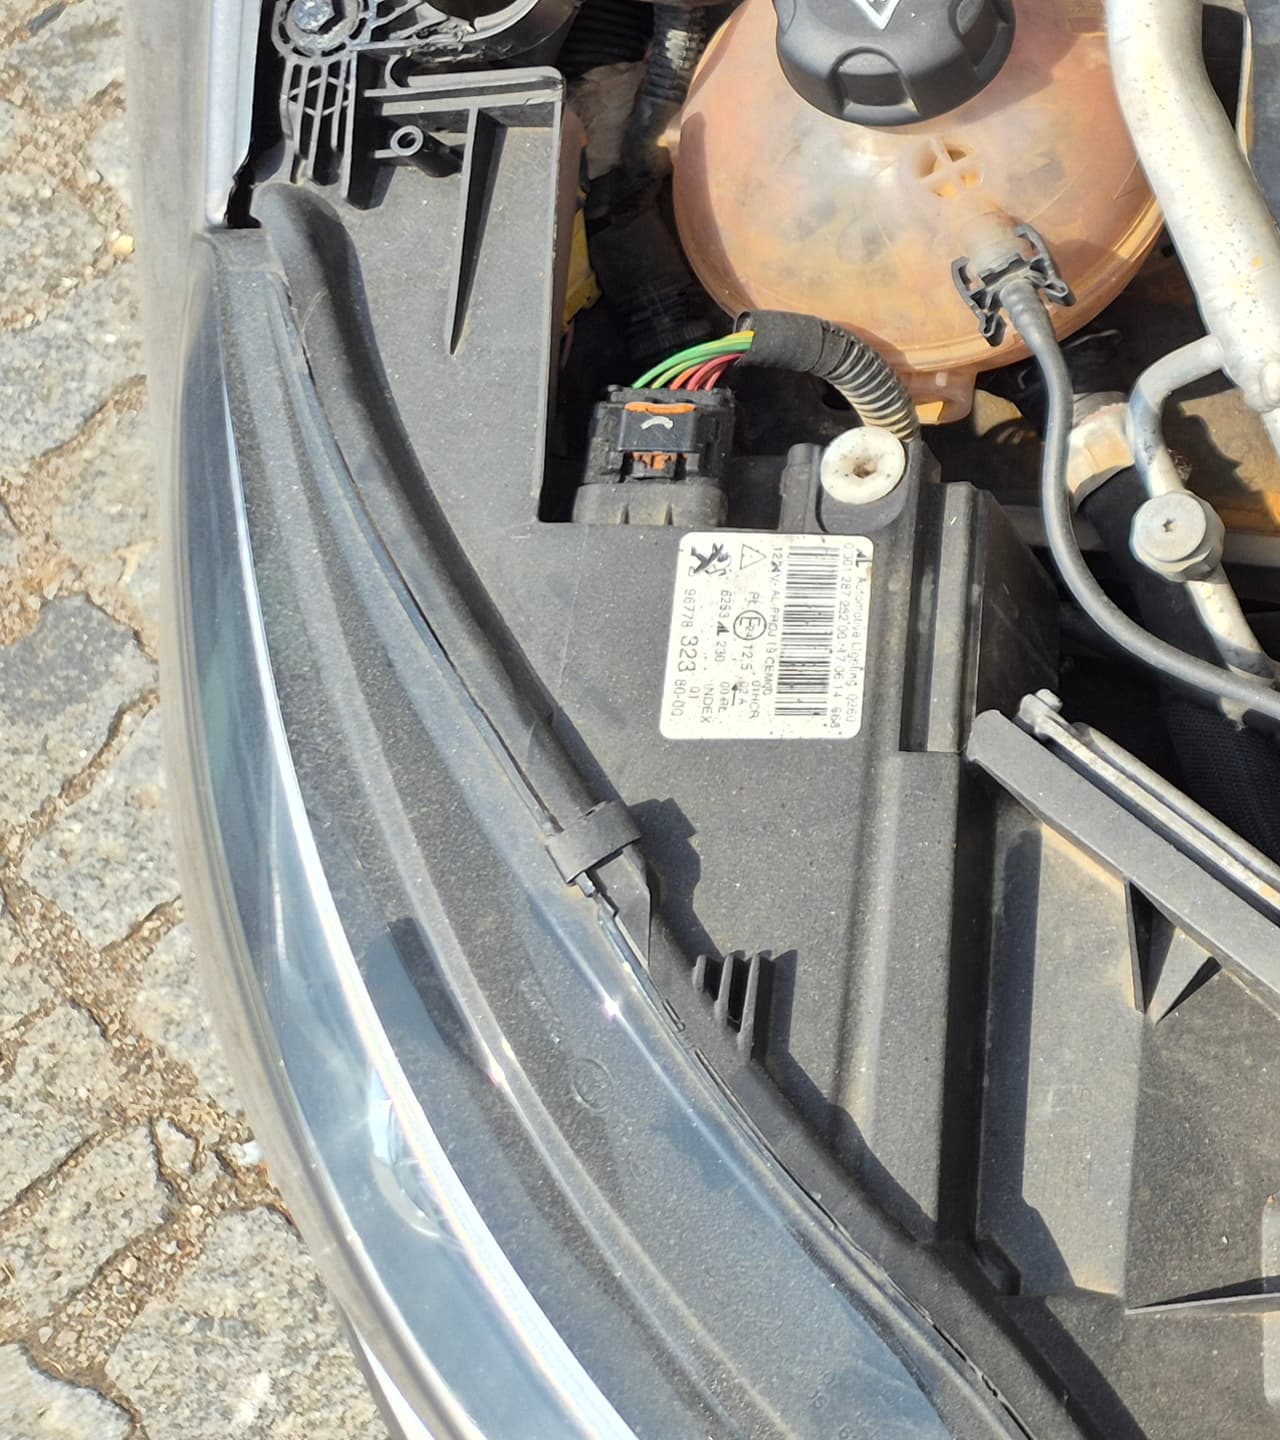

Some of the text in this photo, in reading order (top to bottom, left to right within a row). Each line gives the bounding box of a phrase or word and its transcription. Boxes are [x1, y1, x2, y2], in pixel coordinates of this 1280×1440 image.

[839, 576, 852, 596] 287
[676, 635, 699, 672] 323
[713, 640, 727, 662] 230
[699, 683, 715, 723] INDEX
